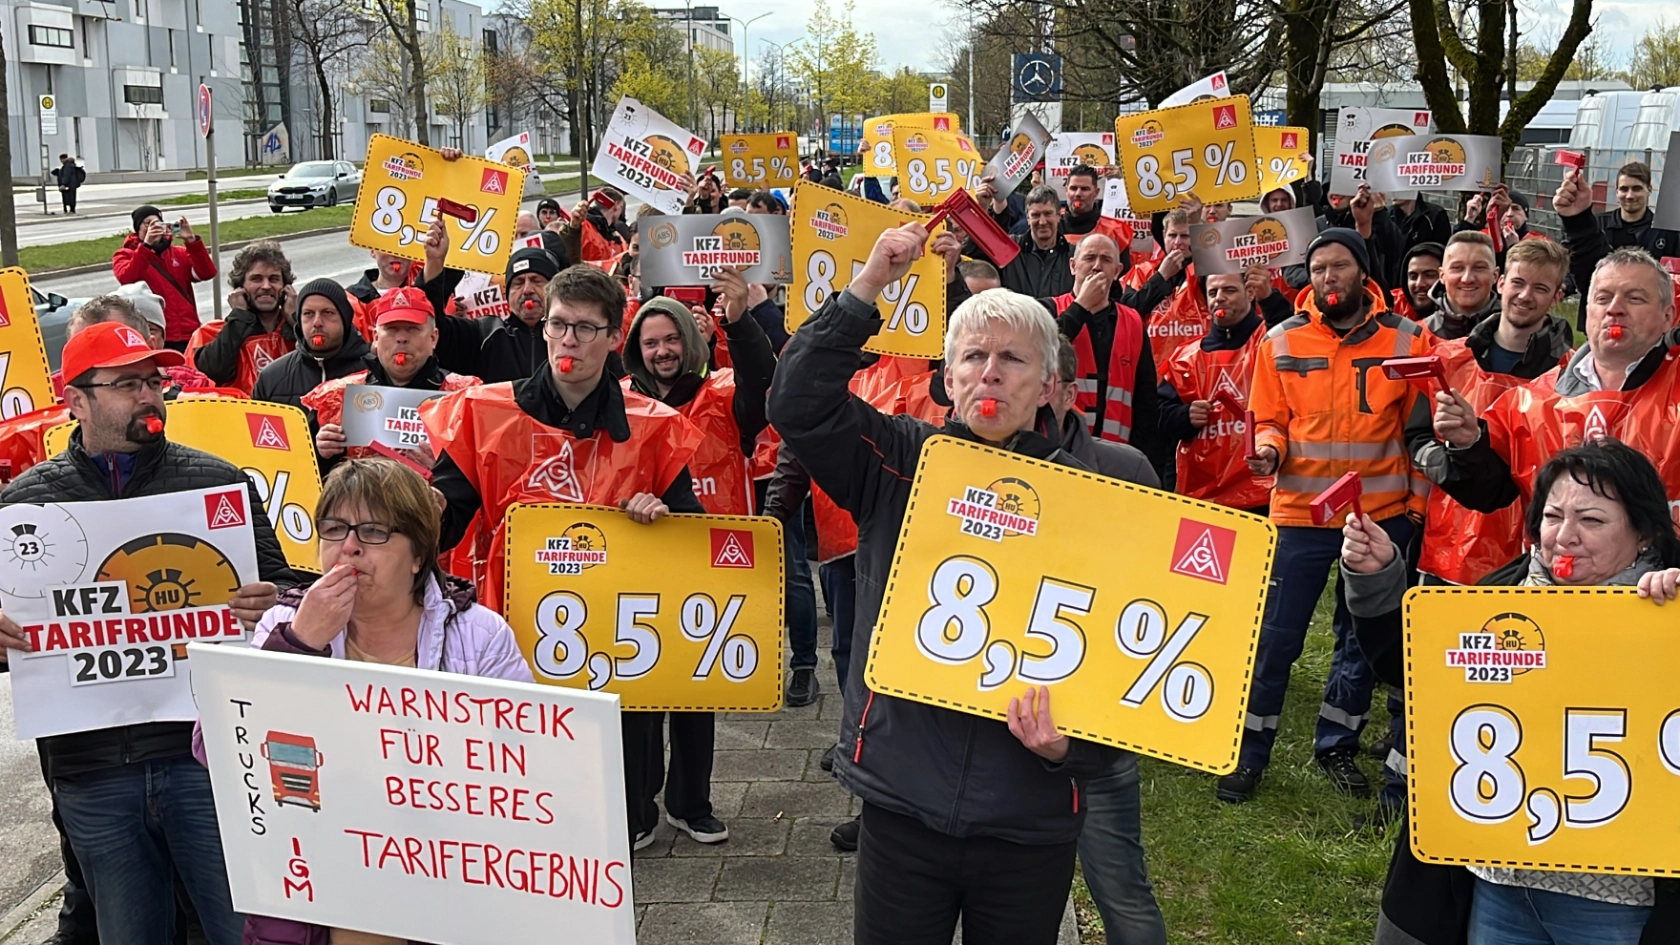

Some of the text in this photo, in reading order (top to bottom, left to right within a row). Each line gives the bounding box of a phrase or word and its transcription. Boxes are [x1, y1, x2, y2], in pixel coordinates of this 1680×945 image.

[624, 136, 650, 158] KFZ
[1353, 141, 1370, 153] KF
[390, 156, 404, 166] KFZ
[1004, 142, 1036, 178] TARIFRUNDE
[1006, 154, 1019, 168] KFZ
[1060, 158, 1078, 166] KFZ
[1409, 153, 1430, 163] KFZ
[383, 162, 422, 178] TARIFRUNDE
[390, 170, 407, 180] 2023
[607, 142, 682, 192] TARIFRUNDE
[731, 156, 793, 183] 8,5 %
[1017, 160, 1032, 177] 2023
[1135, 147, 1198, 202] 8,5
[1204, 140, 1247, 188] %
[1270, 157, 1299, 183] %
[1398, 165, 1464, 174] TARIFRUNDE
[617, 164, 652, 189] 2023
[908, 158, 981, 198] 8,5 %
[1411, 176, 1440, 185] 2023
[817, 211, 829, 221] KFZ
[1114, 208, 1134, 219] KFZ
[457, 204, 500, 256] %
[657, 230, 670, 240] ABS
[810, 219, 848, 235] TARIFRUNDE
[818, 229, 834, 240] 2023
[1134, 230, 1146, 239] 23
[696, 238, 720, 250] KFZ
[1226, 240, 1288, 259] TARIFRUNDE
[1236, 236, 1256, 247] KFZ
[684, 252, 760, 265] TARIFRUNDE
[473, 287, 500, 306] KFZ
[880, 274, 930, 336] %
[1147, 320, 1204, 338] treiken
[400, 408, 422, 420] KF
[386, 419, 426, 433] TARIF
[240, 466, 314, 545] %
[965, 487, 995, 508] KFZ
[1004, 501, 1017, 511] HU
[950, 500, 1037, 534] TARIFRUNDE
[962, 518, 1002, 540] 2023
[18, 541, 40, 556] 23
[548, 538, 570, 550] KFZ
[536, 552, 605, 563] TARIFRUNDE
[550, 563, 581, 574] 2023
[52, 585, 123, 617] KFZ
[154, 588, 180, 606] HU
[22, 608, 242, 652] TARIFRUNDE
[534, 590, 759, 691] 8,5 %
[914, 554, 1216, 723] 8,5 %
[1462, 635, 1492, 650] KFZ
[1505, 639, 1518, 648] HU
[72, 646, 169, 683] 2023
[1448, 652, 1544, 666] TARIFRUNDE
[1468, 667, 1510, 682] 2023
[345, 682, 576, 741] WARNSTREIK
[380, 727, 526, 776] FÜR EIN
[1448, 702, 1632, 846] 8,5
[385, 776, 556, 825] BESSERES
[344, 828, 626, 909] TARIFERGEBNIS
